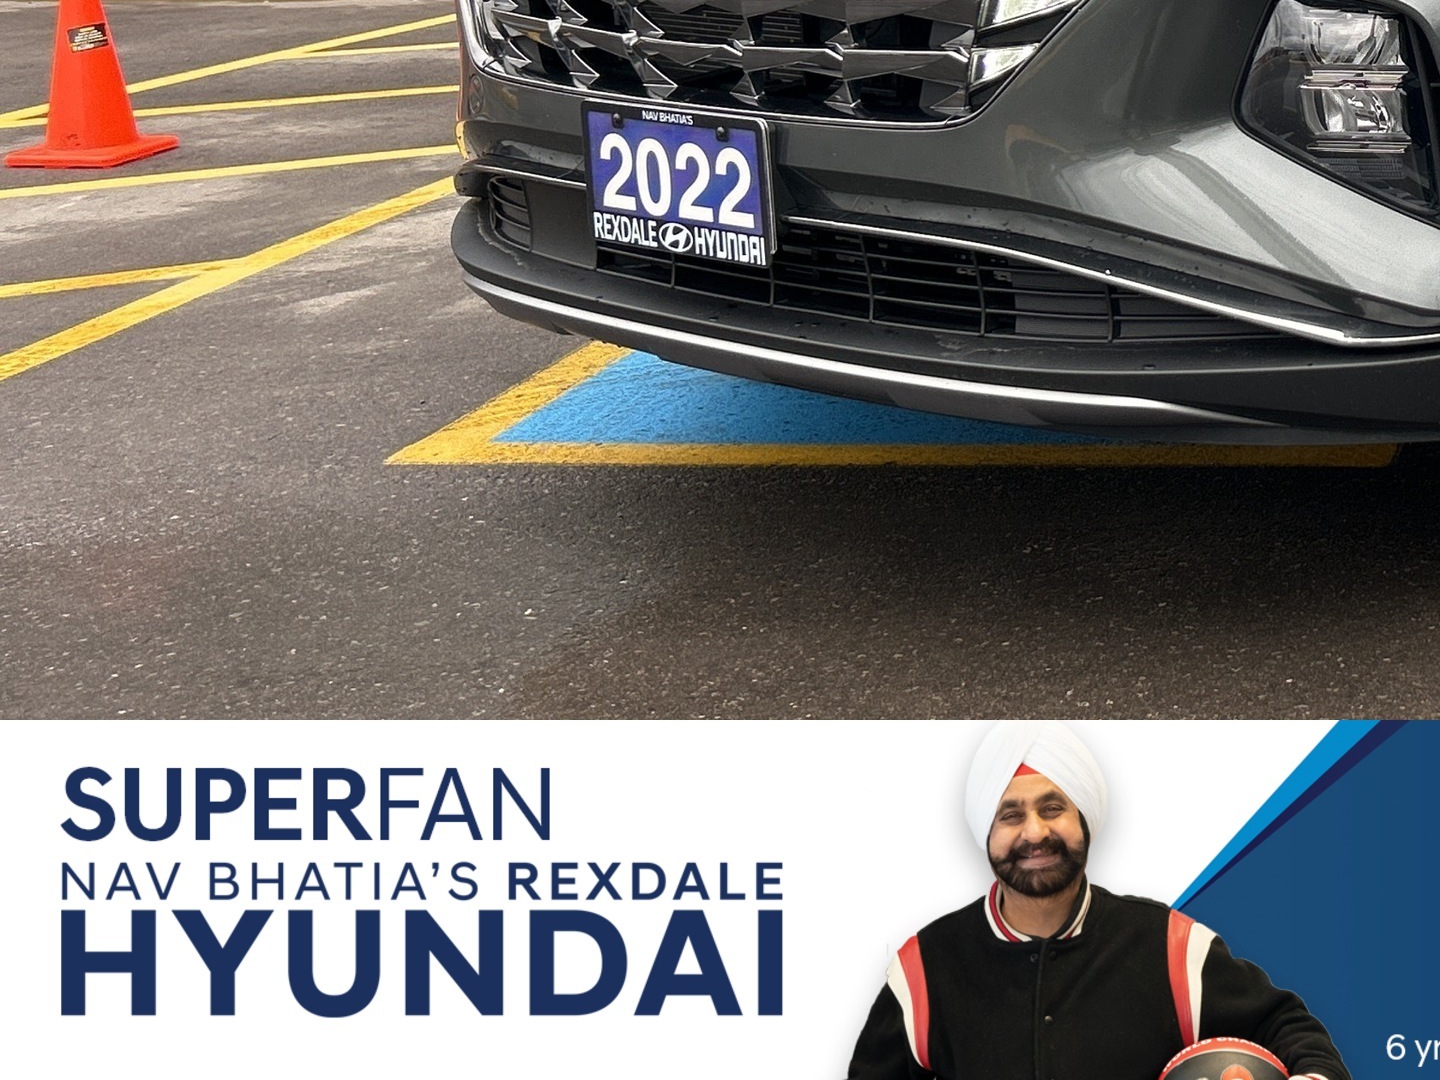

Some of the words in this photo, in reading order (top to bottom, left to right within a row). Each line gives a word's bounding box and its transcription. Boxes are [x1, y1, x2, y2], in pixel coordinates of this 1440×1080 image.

[642, 110, 659, 121] NAV
[659, 112, 694, 126] BHATIA'S
[600, 133, 755, 229] 2022
[593, 211, 659, 247] REXDALE
[694, 226, 767, 265] HYUNDAI
